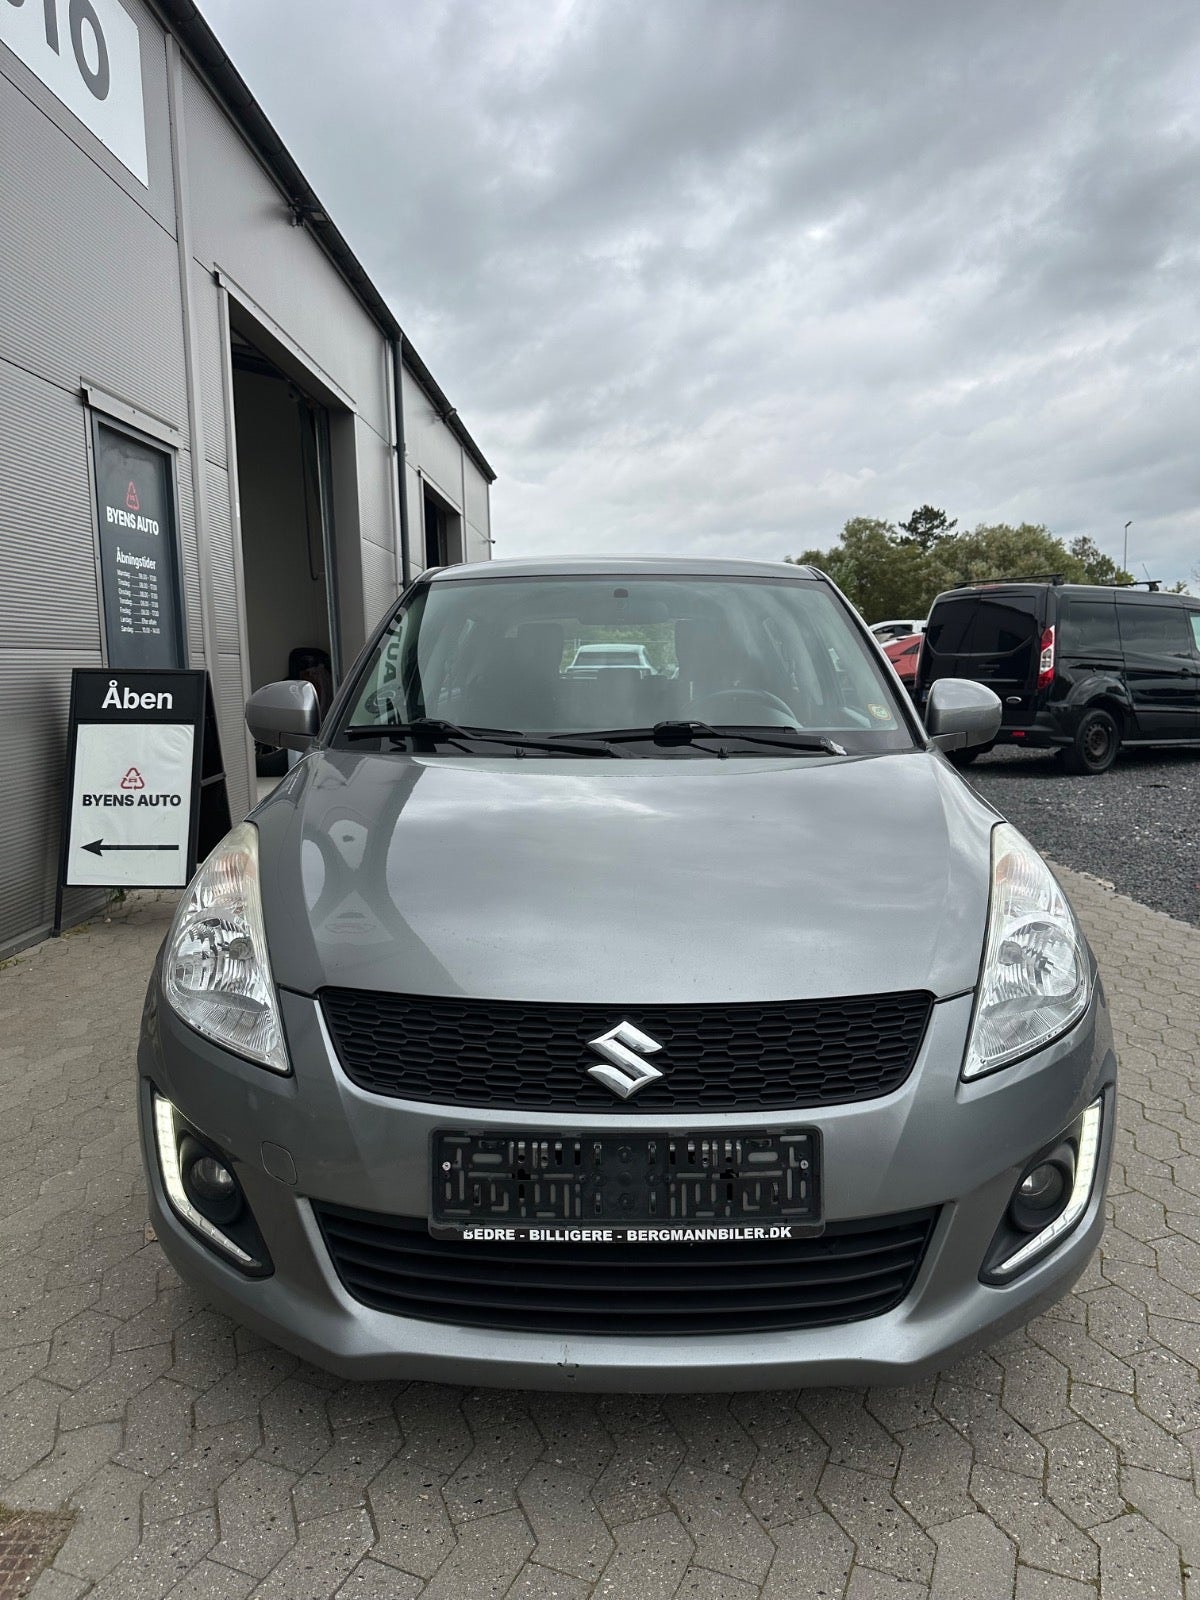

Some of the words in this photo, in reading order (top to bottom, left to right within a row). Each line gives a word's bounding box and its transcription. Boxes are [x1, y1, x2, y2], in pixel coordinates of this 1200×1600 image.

[106, 506, 136, 529] BYENS
[137, 515, 159, 535] AUTO
[101, 679, 173, 710] Åben
[82, 794, 134, 807] BYENS
[137, 794, 182, 807] AUTO
[463, 1228, 515, 1241] BEDRE
[529, 1229, 613, 1242] BILLIGERE
[626, 1226, 793, 1242] BERGMANNBILER.DK
